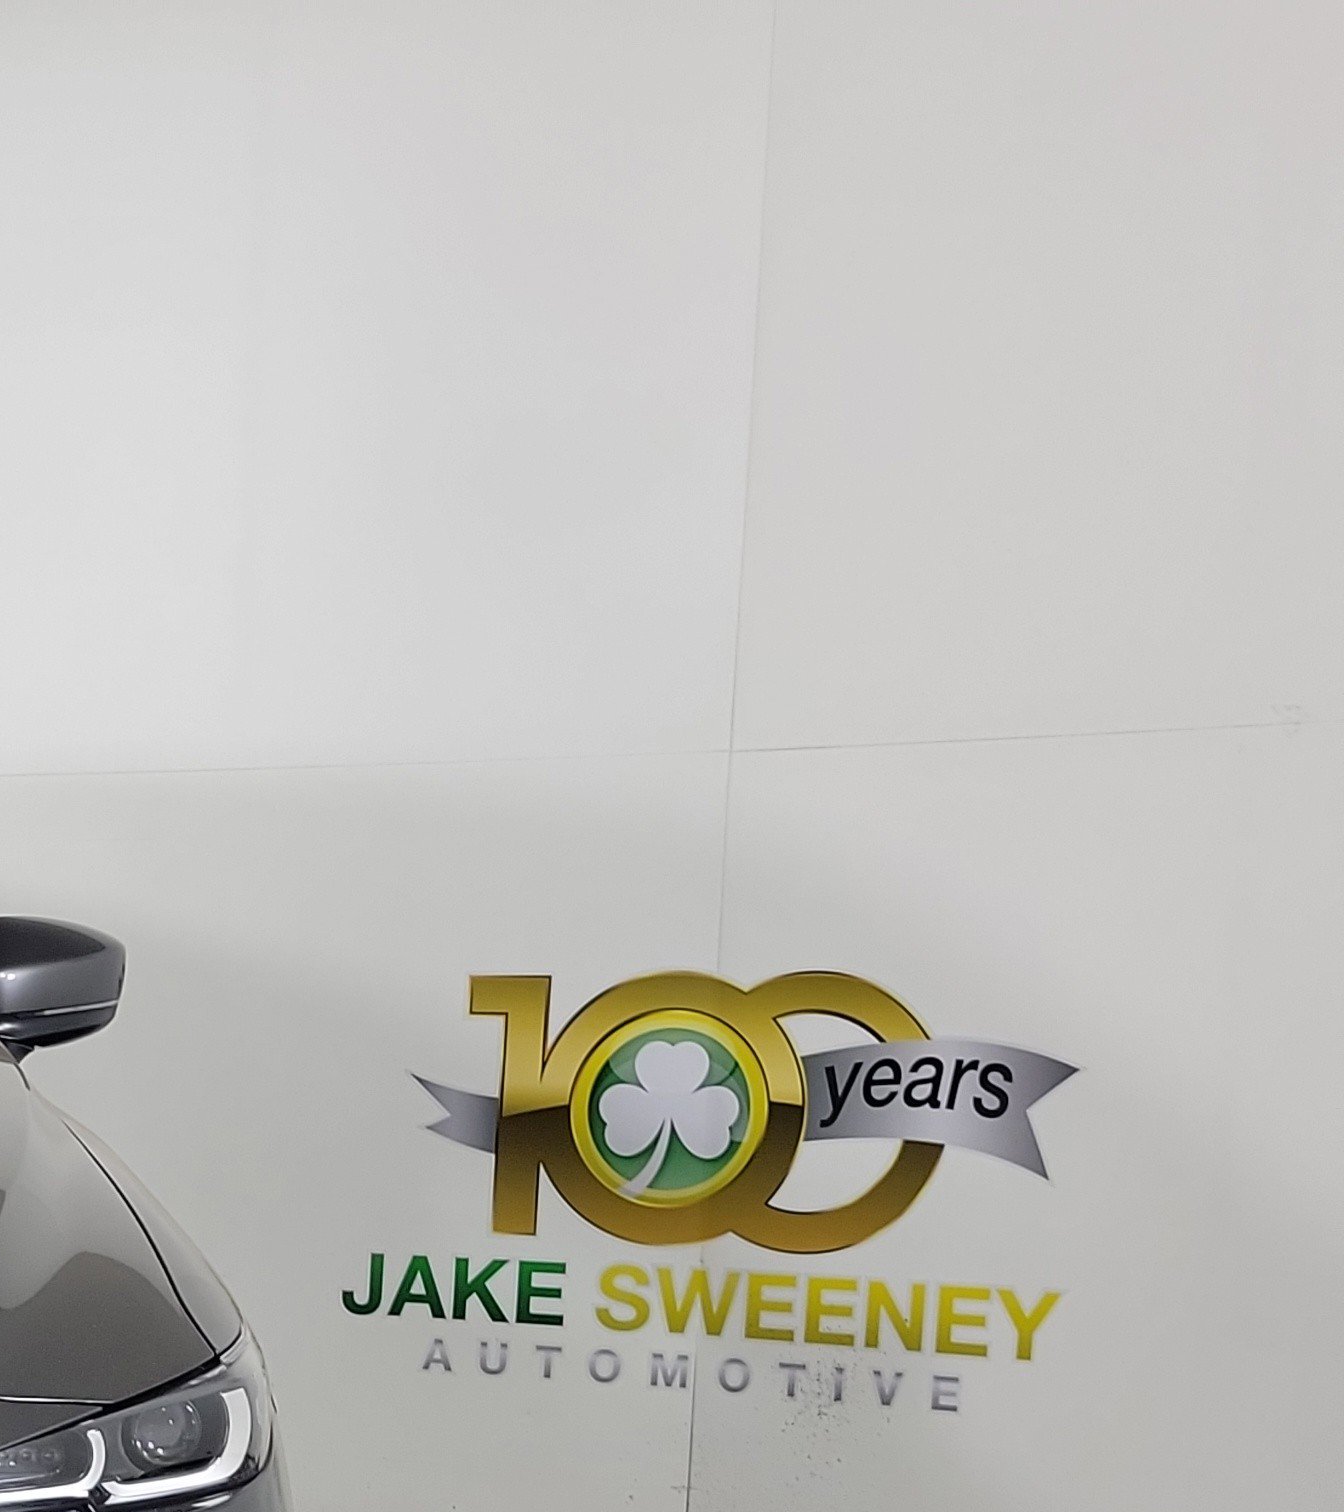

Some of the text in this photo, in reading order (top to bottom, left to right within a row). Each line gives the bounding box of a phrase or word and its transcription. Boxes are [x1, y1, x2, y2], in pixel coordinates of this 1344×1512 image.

[467, 969, 1015, 1255] 100 years
[340, 1252, 1062, 1362] JAKE SWEENEY
[420, 1337, 961, 1413] AUTOMOTIVE
